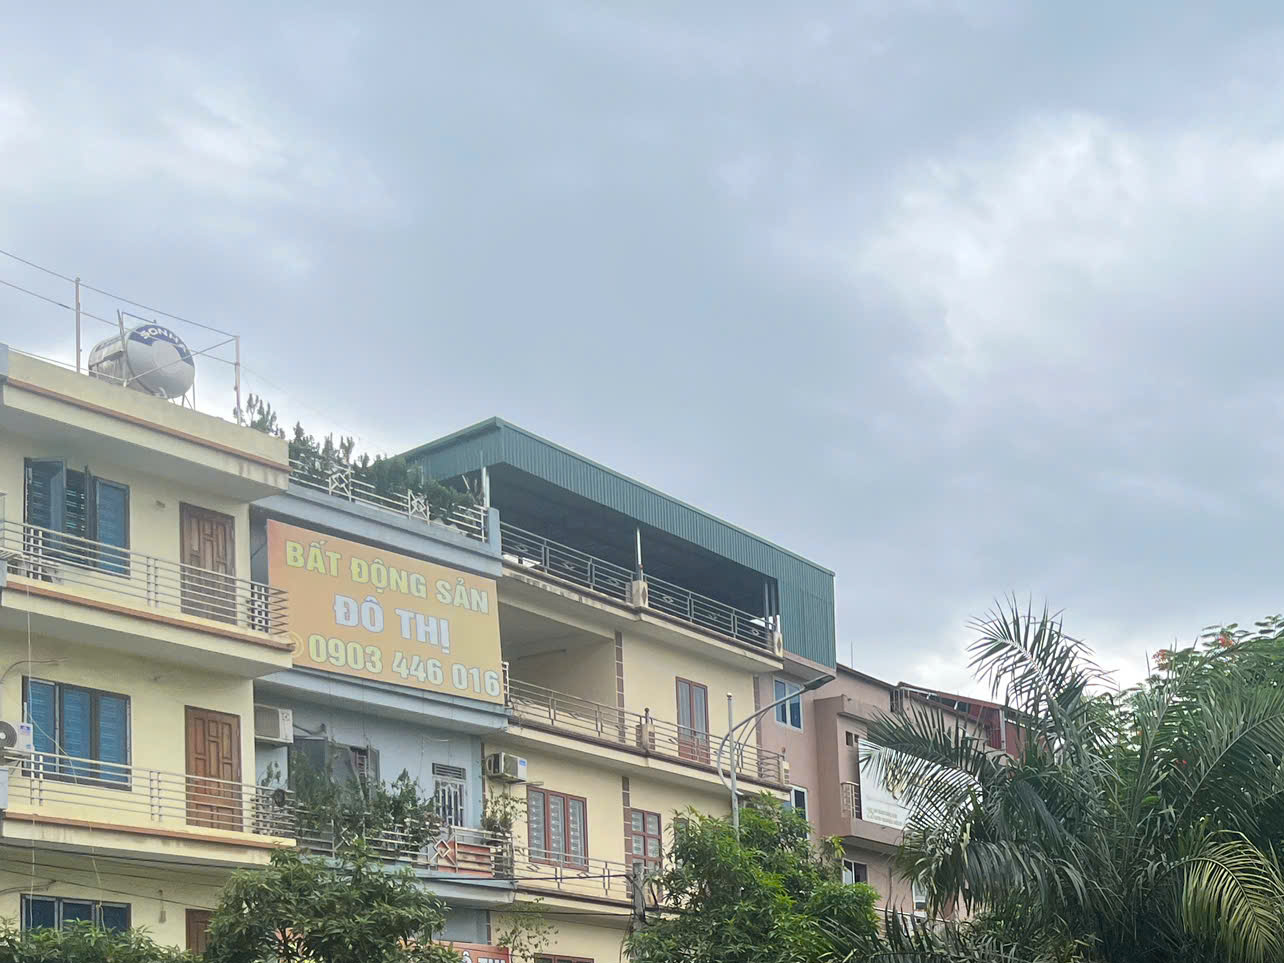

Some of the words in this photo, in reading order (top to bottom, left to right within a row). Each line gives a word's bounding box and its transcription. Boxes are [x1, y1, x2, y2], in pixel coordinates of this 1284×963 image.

[285, 540, 343, 577] BẤT
[350, 559, 428, 599] ĐỘNG
[435, 577, 489, 614] SẢN
[333, 594, 385, 634] ĐÔ
[395, 608, 450, 655] THỊ
[308, 634, 383, 674] 0903
[392, 651, 444, 686] 446
[451, 663, 501, 697] 016
